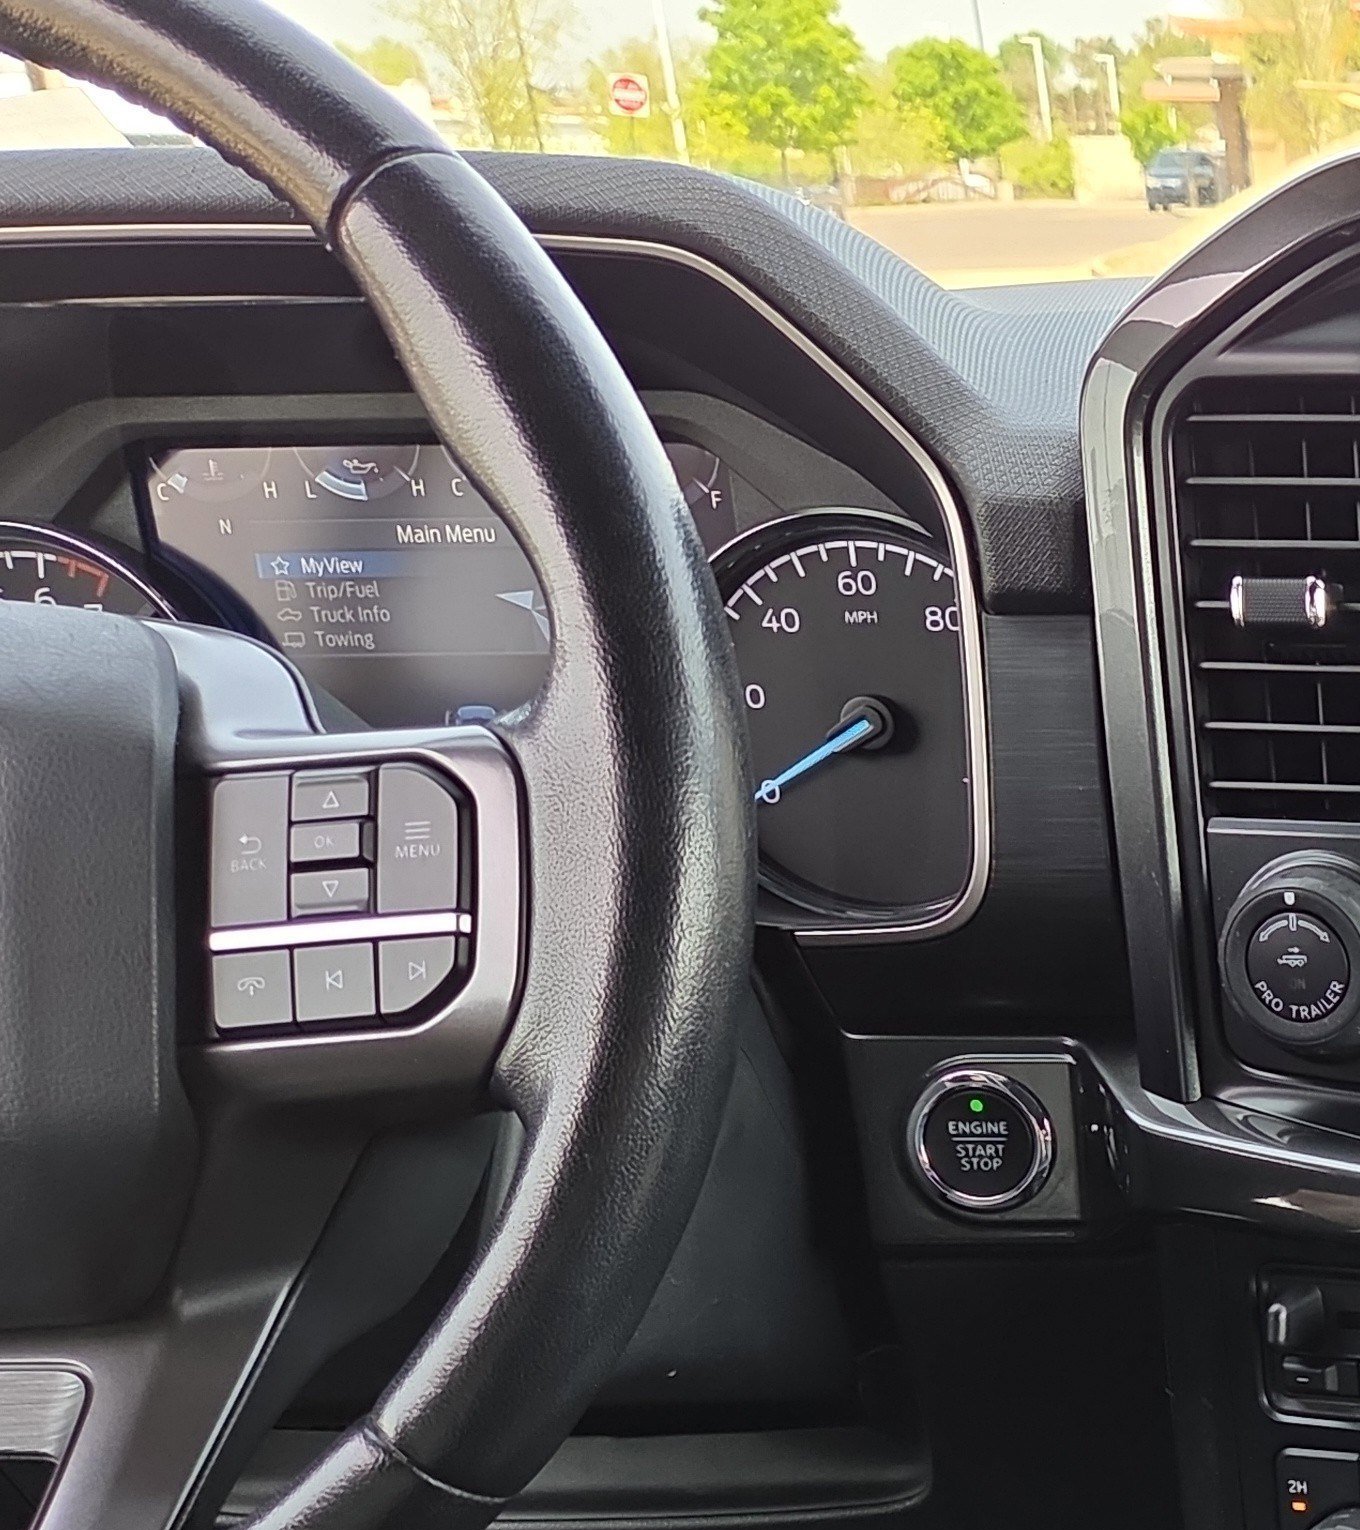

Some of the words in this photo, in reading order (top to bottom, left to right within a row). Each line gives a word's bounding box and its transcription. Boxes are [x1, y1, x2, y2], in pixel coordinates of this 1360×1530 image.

[157, 482, 169, 501] C
[264, 481, 277, 498] H
[306, 481, 317, 499] L
[412, 480, 424, 497] H
[451, 479, 464, 497] C
[711, 491, 722, 509] F
[220, 519, 232, 535] N
[397, 525, 442, 543] Main
[446, 525, 496, 543] Menu
[301, 558, 363, 575] MyView
[305, 581, 379, 600] Trip/Fuel
[837, 570, 877, 597] 60
[310, 607, 354, 623] Truck
[358, 606, 391, 623] Info
[762, 608, 799, 633] 40
[845, 610, 877, 624] MPH
[314, 631, 375, 650] Towing
[314, 835, 336, 848] OK
[395, 844, 440, 859] MENU
[230, 858, 266, 873] BACK
[1254, 980, 1284, 1012] PRO
[1289, 980, 1345, 1020] TRAILER
[948, 1121, 1009, 1135] ENGINE
[956, 1144, 1005, 1158] START
[960, 1158, 1003, 1171] STOP
[1288, 1480, 1308, 1495] 2H
